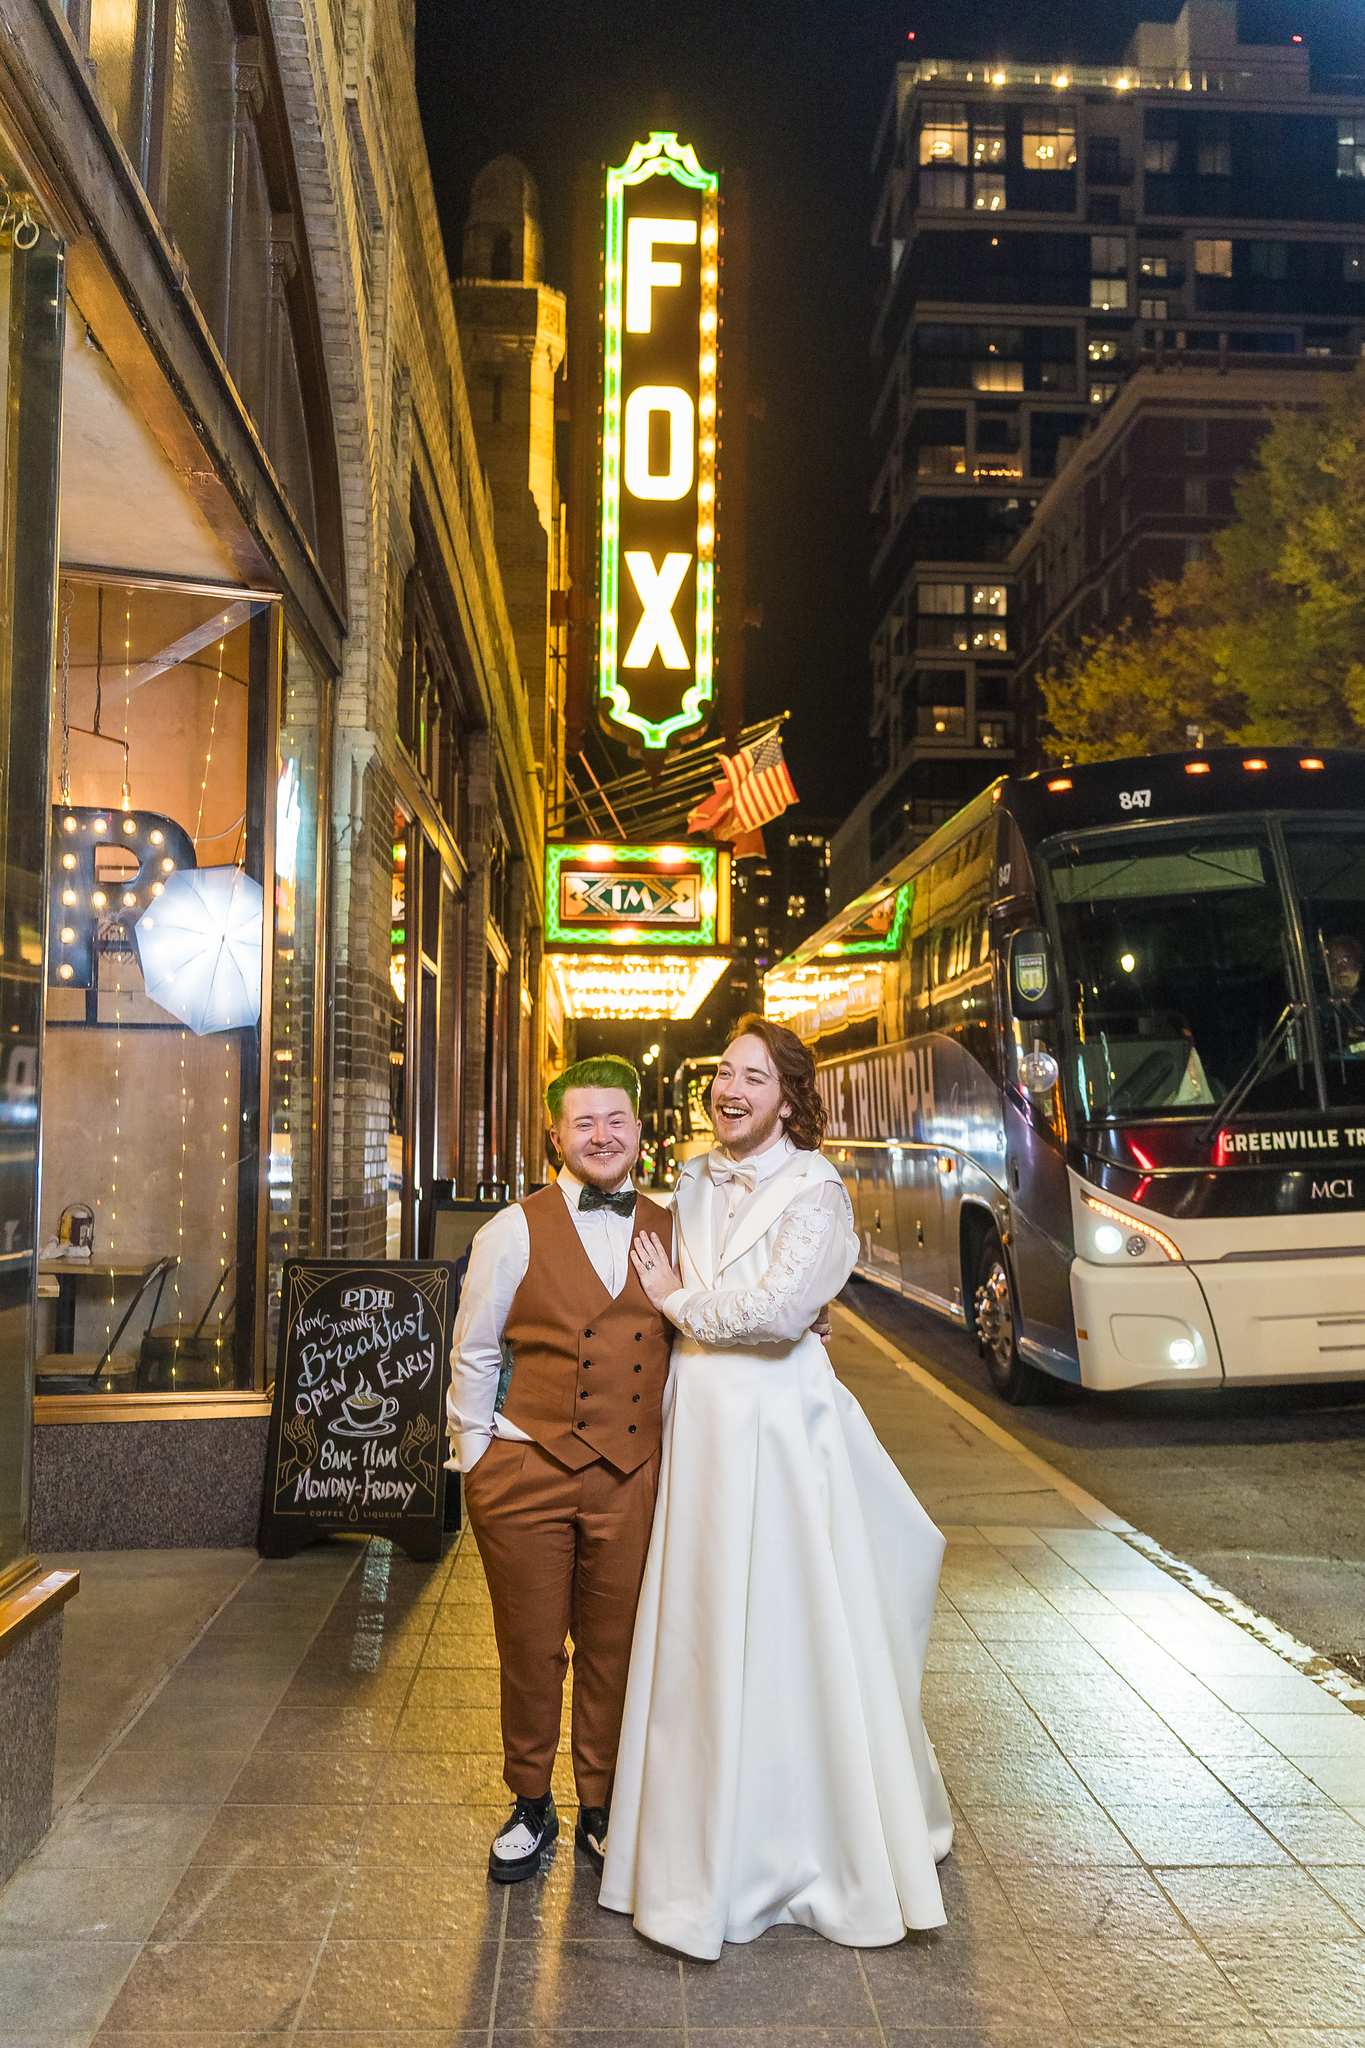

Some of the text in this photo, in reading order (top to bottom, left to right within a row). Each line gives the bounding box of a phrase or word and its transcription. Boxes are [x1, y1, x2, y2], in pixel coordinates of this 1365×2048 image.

[622, 217, 697, 670] FOX
[1119, 789, 1151, 809] 847
[849, 1046, 936, 1137] TRIUMPH
[1223, 1129, 1339, 1152] GREENVILLE
[1311, 1179, 1354, 1199] MCI
[298, 1292, 430, 1387] Breakfast
[296, 1342, 434, 1416] OPEN EARLY
[309, 1509, 344, 1518] COFFEE
